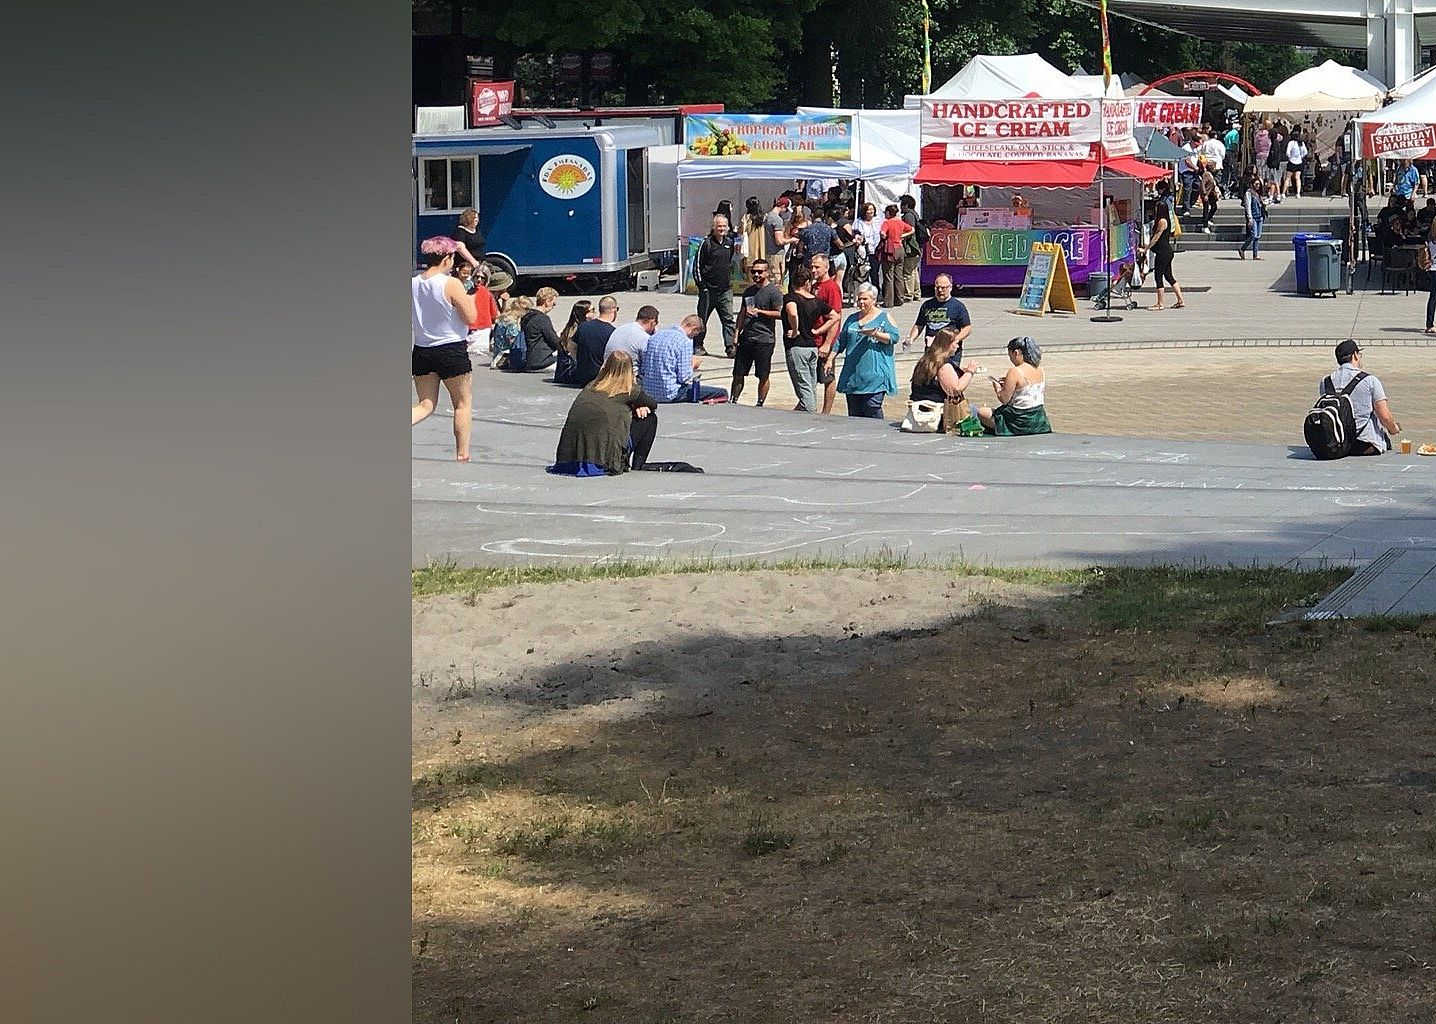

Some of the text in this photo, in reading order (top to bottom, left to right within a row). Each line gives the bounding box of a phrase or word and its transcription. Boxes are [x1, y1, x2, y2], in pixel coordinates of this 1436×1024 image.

[931, 102, 1091, 118] HANDCRAFTED
[1136, 101, 1200, 124] ICE CREAM
[728, 123, 788, 136] TROPICAL
[952, 122, 1071, 137] ICE CREAM
[1375, 129, 1431, 145] SATURDAY
[962, 143, 1015, 152] CHEESECAKE
[1018, 143, 1033, 151] ON
[1042, 143, 1067, 151] STICK
[1383, 138, 1425, 152] MARKET
[930, 232, 1030, 261] SHAVED
